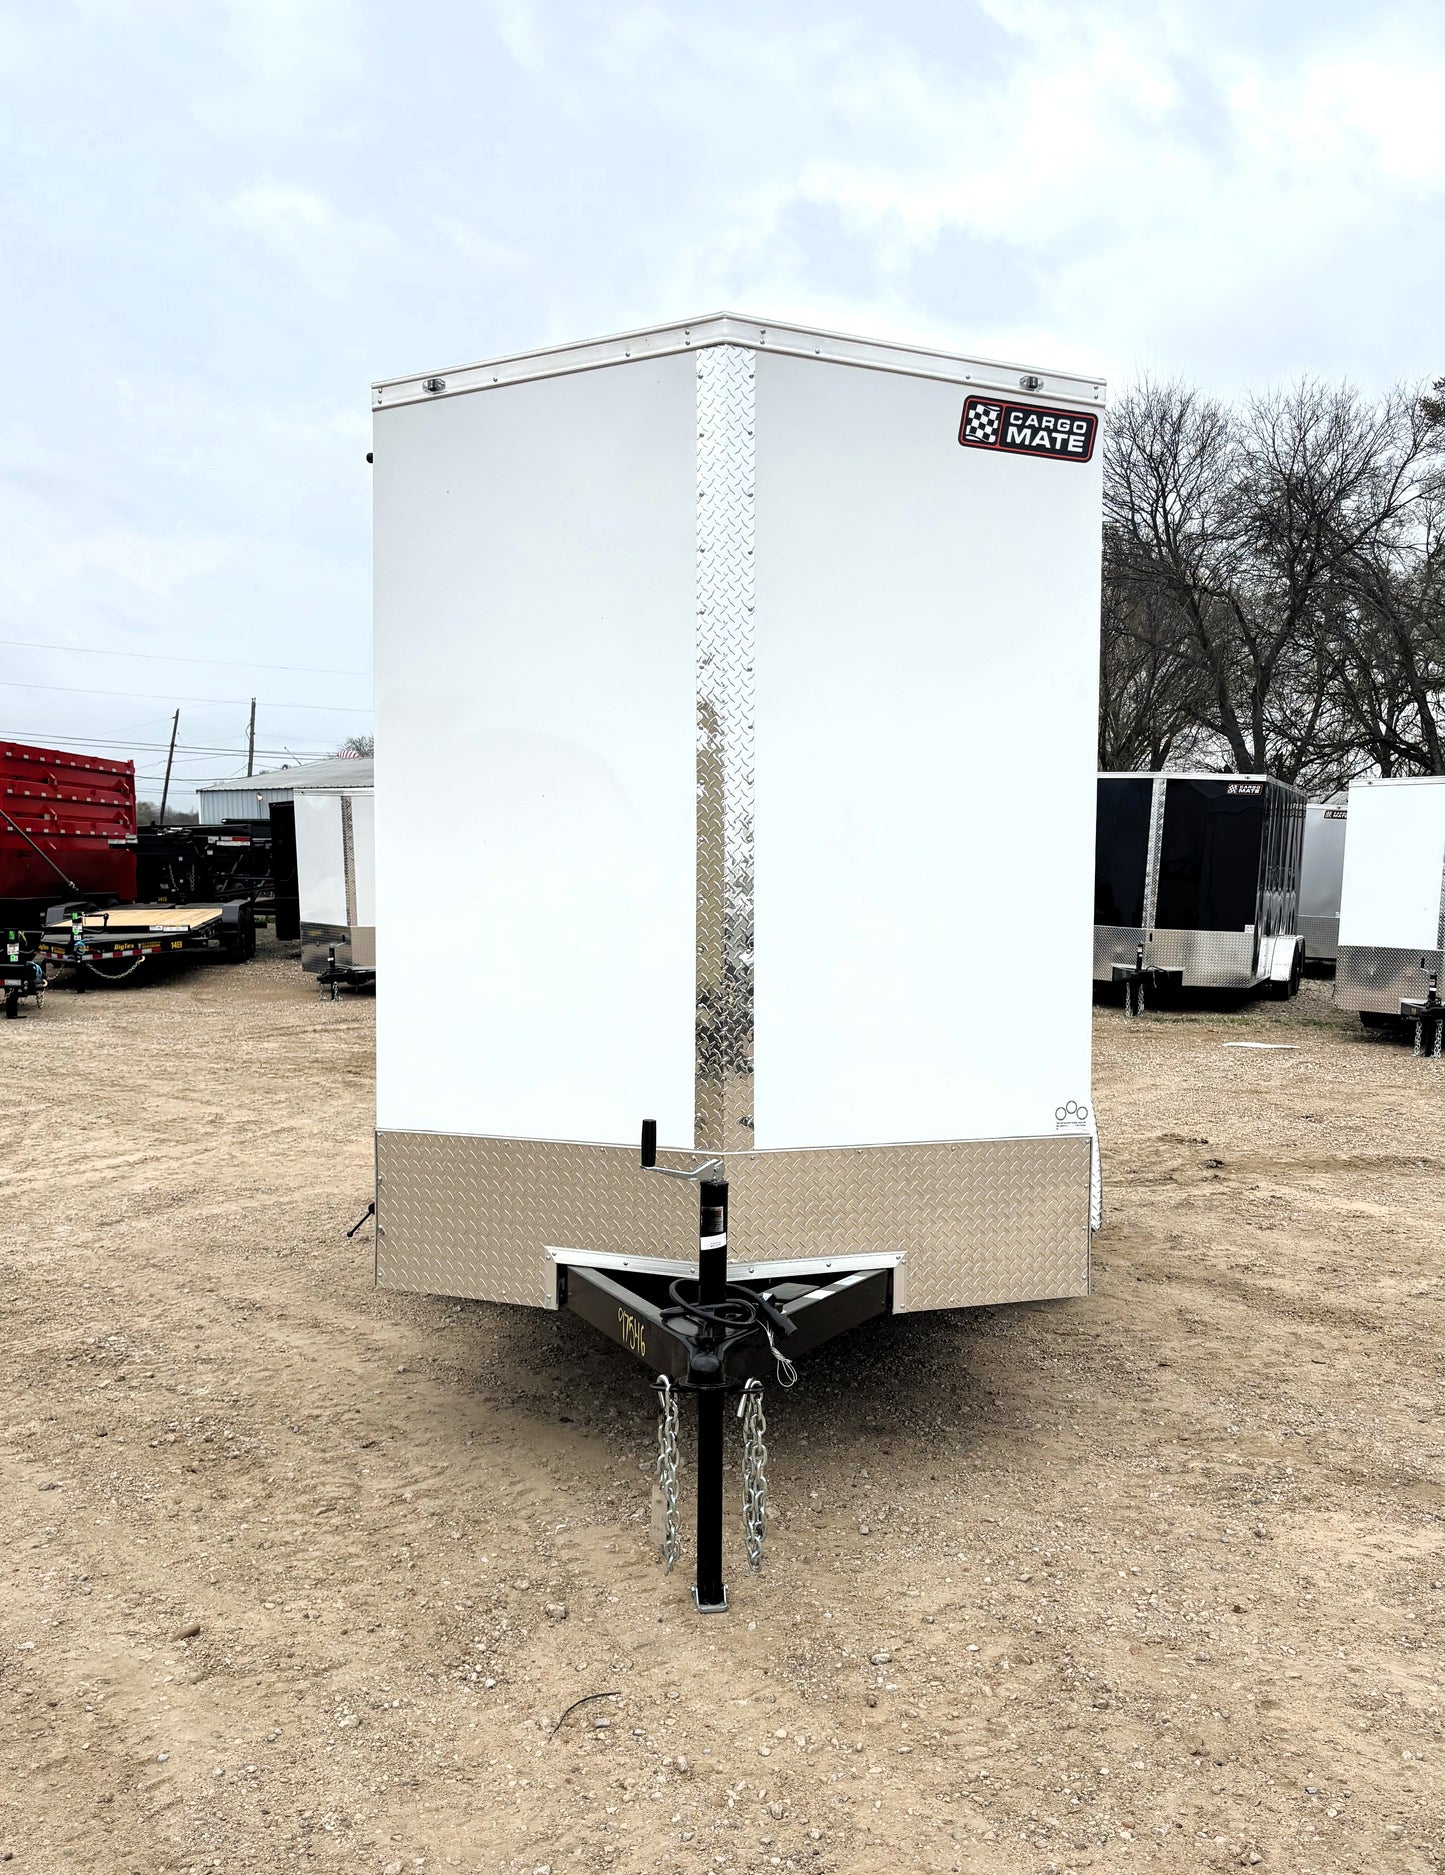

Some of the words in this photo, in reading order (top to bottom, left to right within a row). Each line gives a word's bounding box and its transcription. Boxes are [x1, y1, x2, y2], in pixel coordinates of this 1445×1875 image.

[1009, 411, 1087, 434] CARGO
[1006, 426, 1085, 452] MATE
[617, 1307, 646, 1357] 97546
